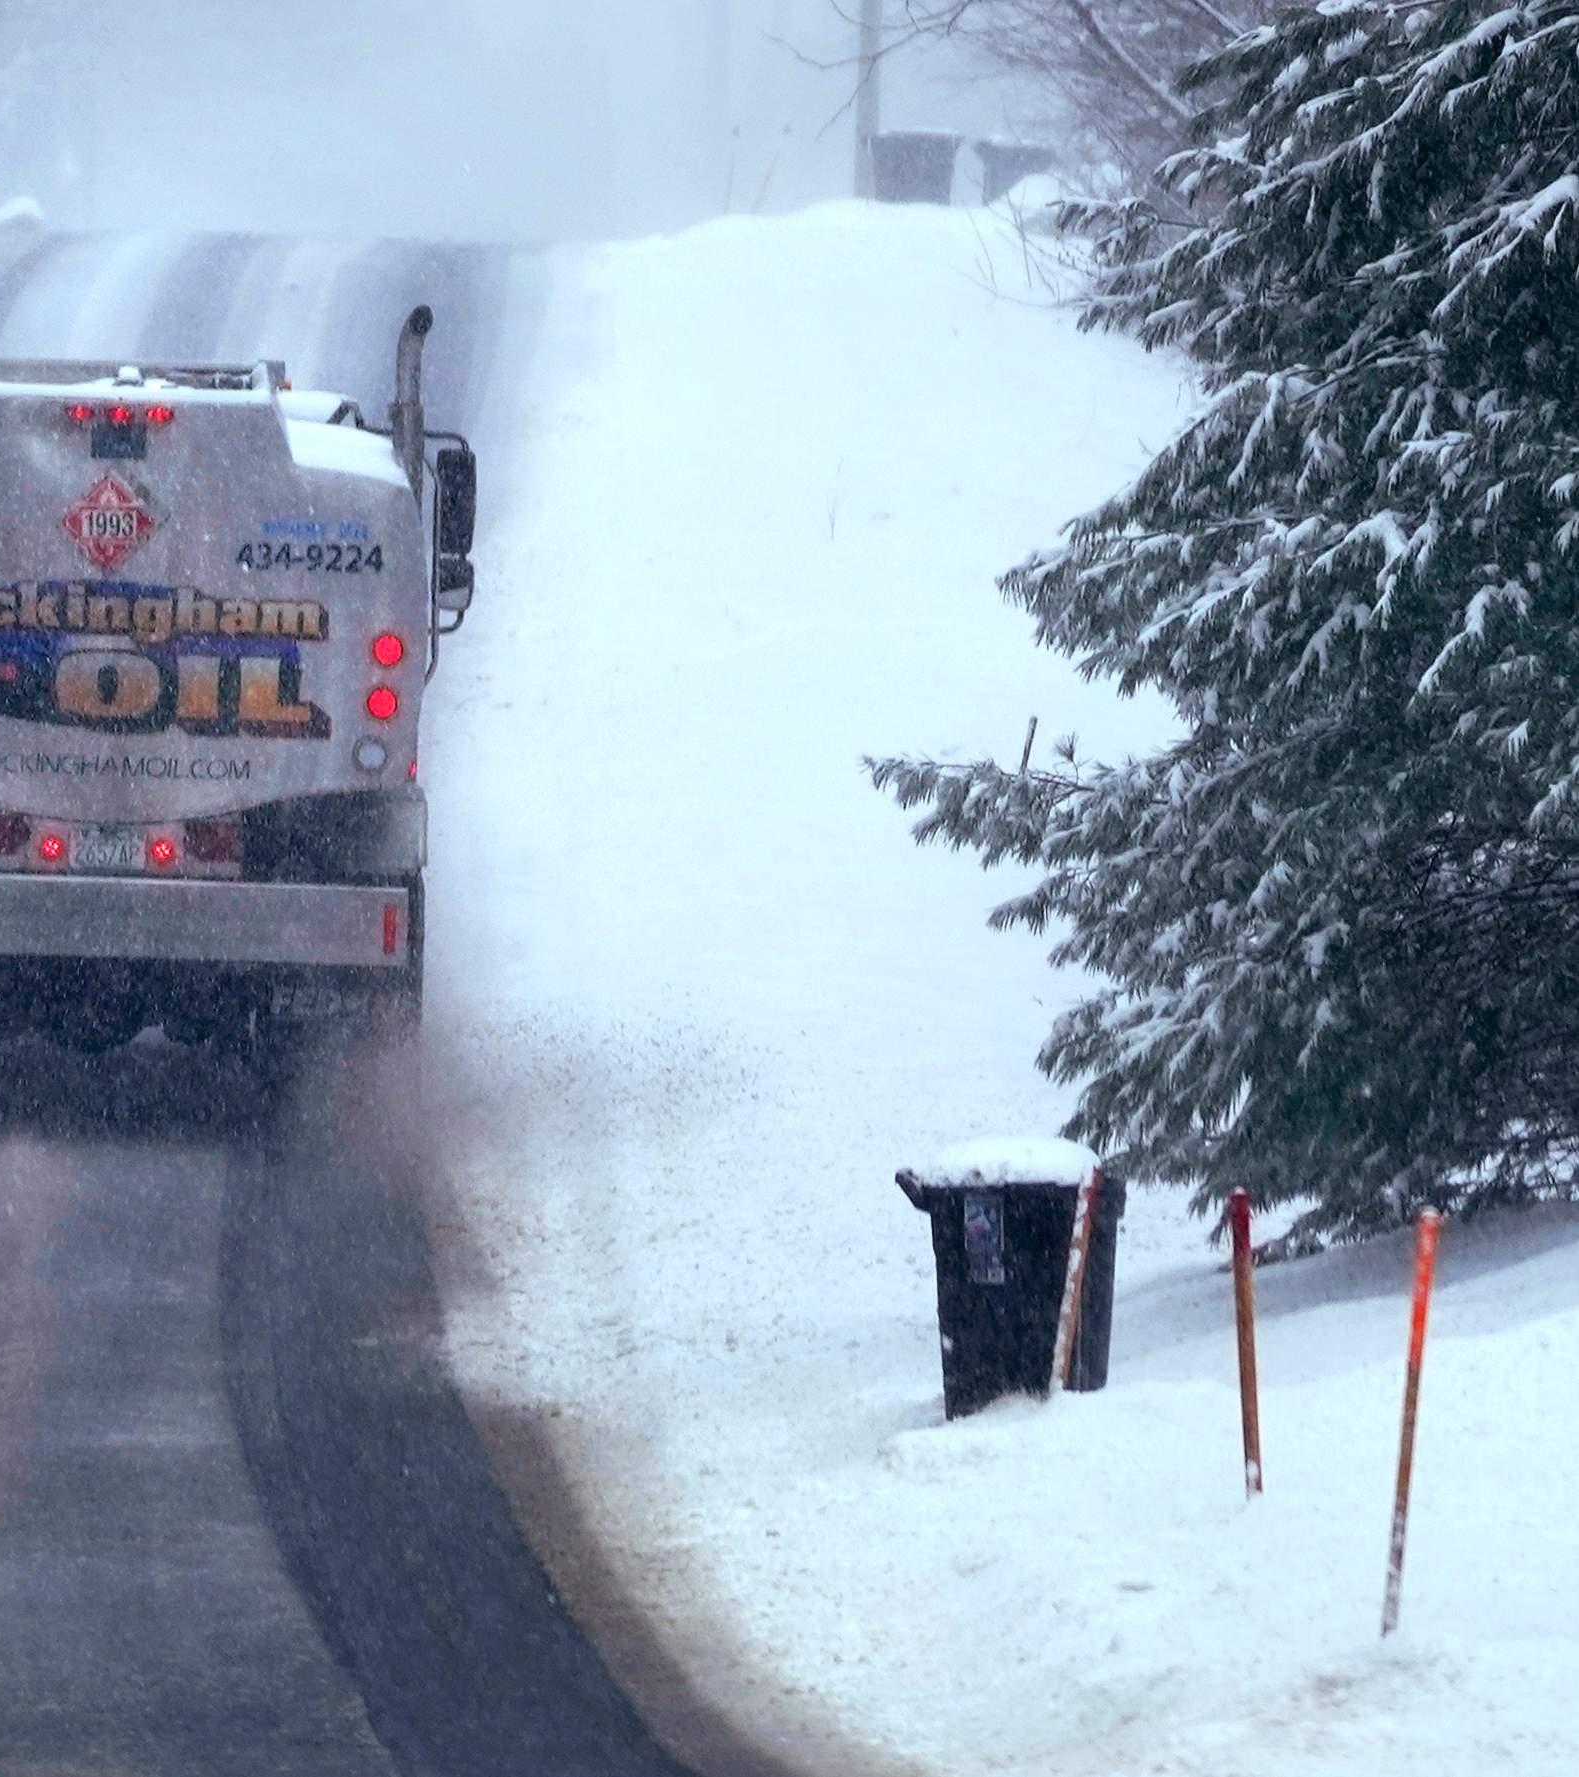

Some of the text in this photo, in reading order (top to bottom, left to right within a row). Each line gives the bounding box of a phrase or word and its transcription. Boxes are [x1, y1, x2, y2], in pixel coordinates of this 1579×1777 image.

[87, 511, 134, 537] 1993
[236, 543, 384, 573] 434-9224
[54, 648, 330, 738] OIL
